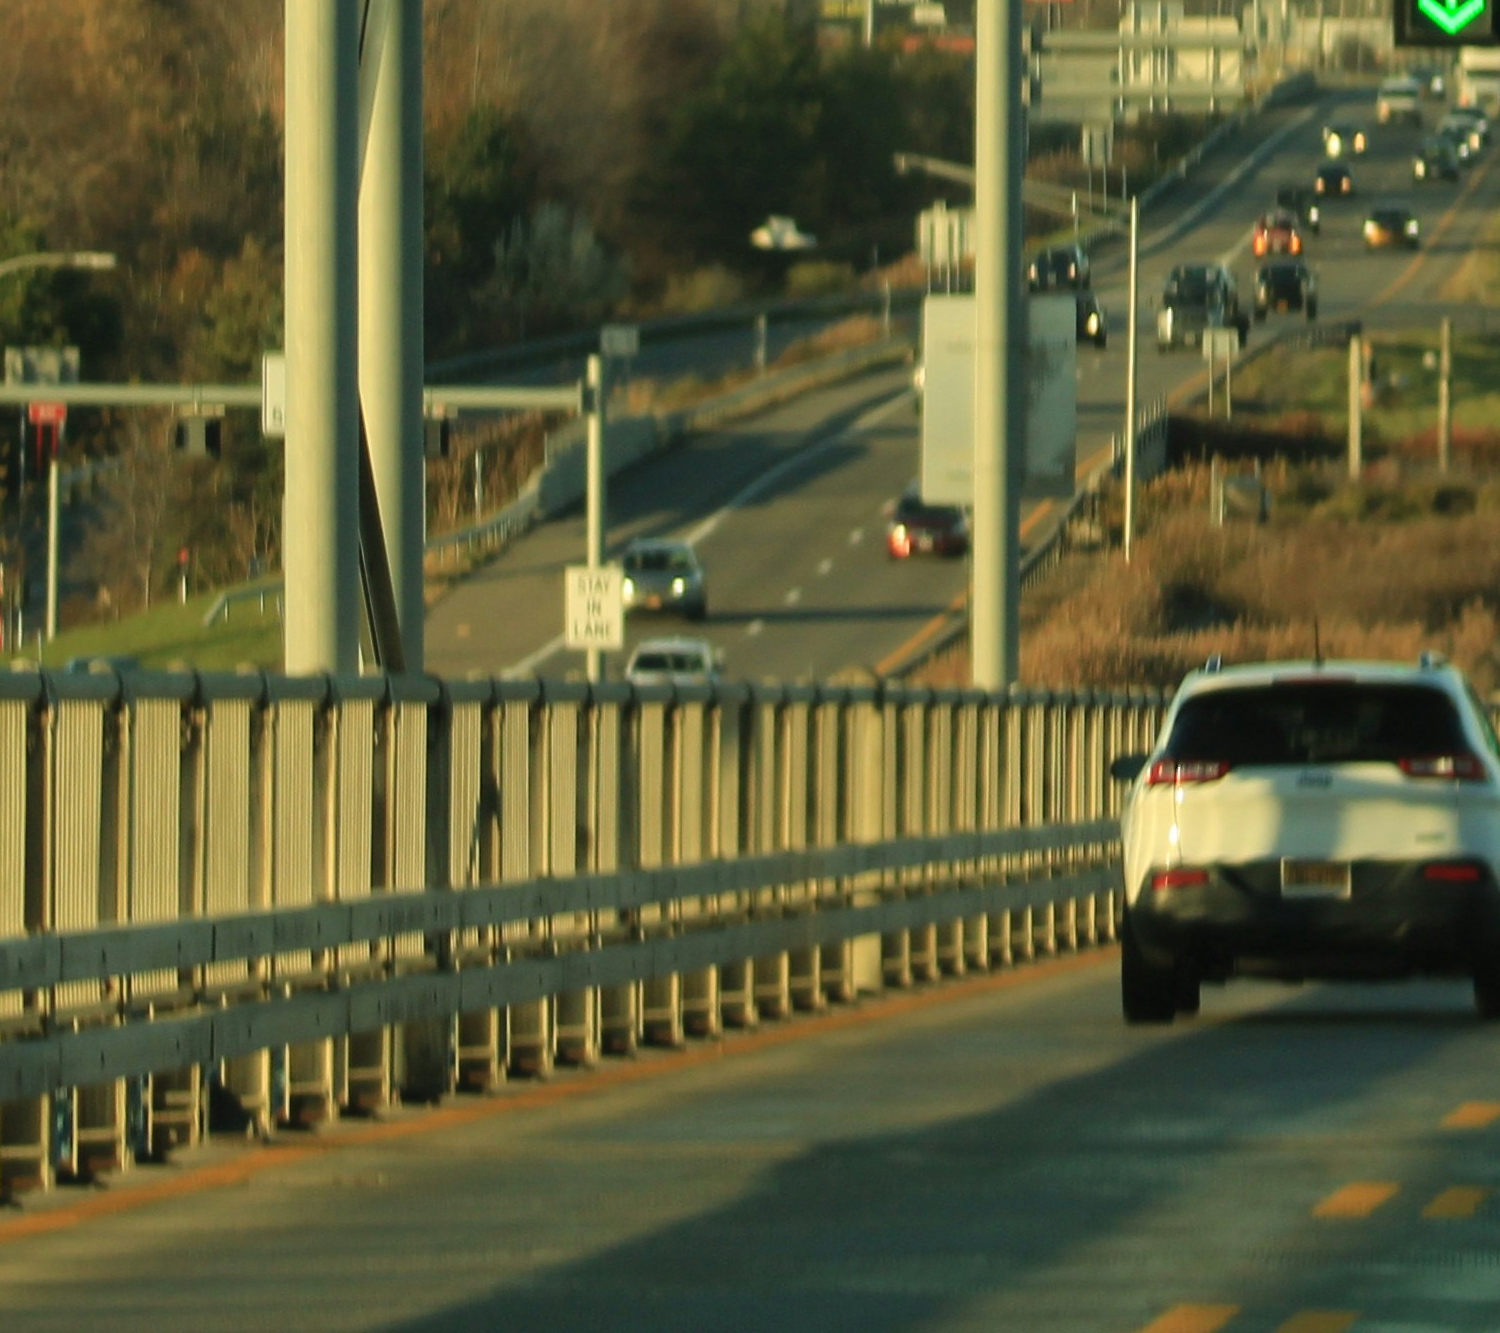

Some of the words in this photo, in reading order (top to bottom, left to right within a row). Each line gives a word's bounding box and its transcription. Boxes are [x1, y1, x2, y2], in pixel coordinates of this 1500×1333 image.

[578, 575, 610, 593] STAY
[586, 597, 602, 614] IN
[574, 619, 610, 639] LANE
